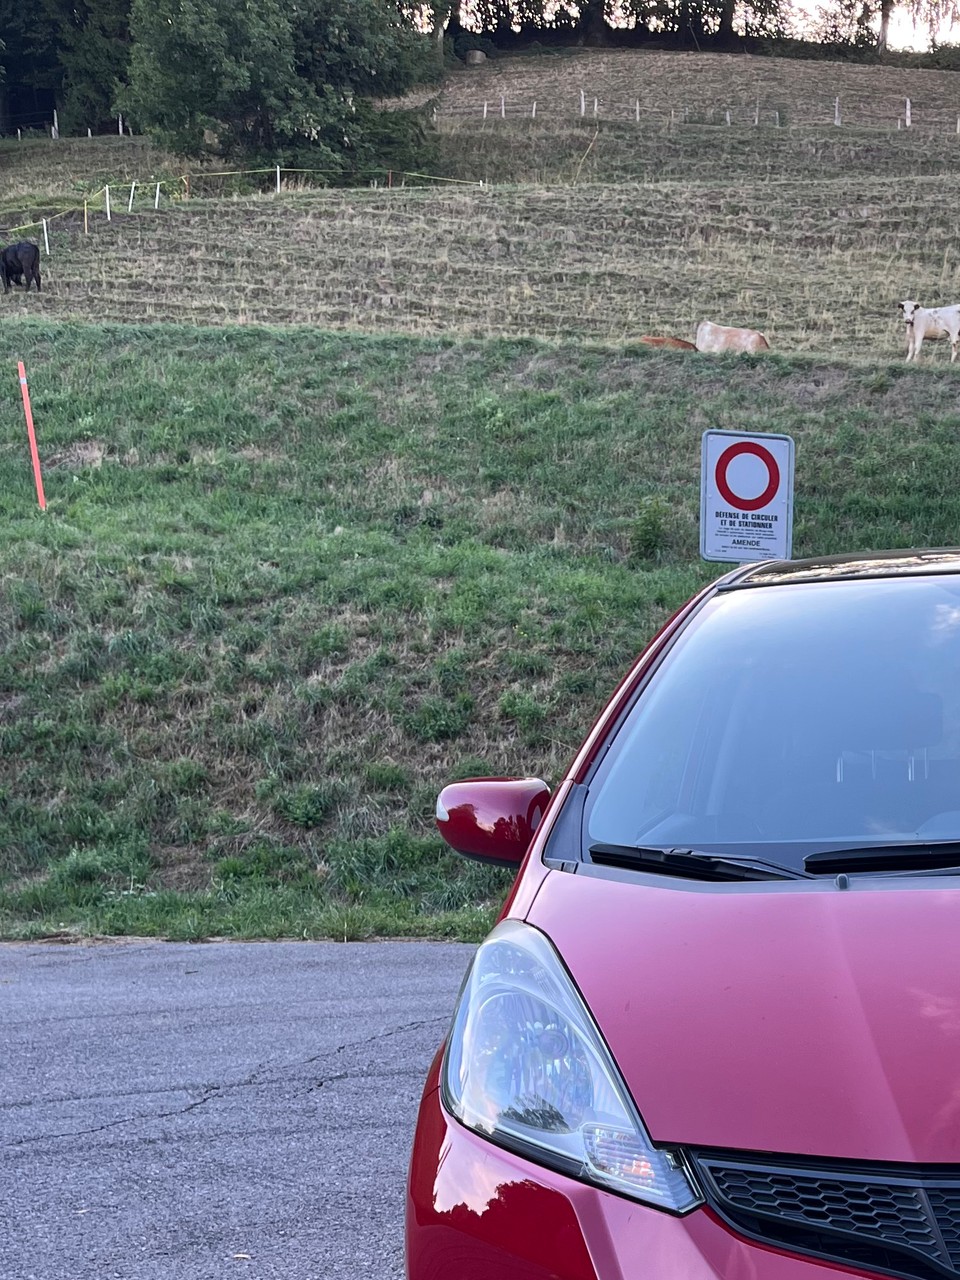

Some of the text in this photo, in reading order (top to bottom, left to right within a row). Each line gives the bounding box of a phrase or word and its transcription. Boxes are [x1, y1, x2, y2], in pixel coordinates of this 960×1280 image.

[751, 514, 778, 522] CIRCULER
[738, 520, 773, 529] STATIONNER
[731, 539, 761, 547] AMENDE
